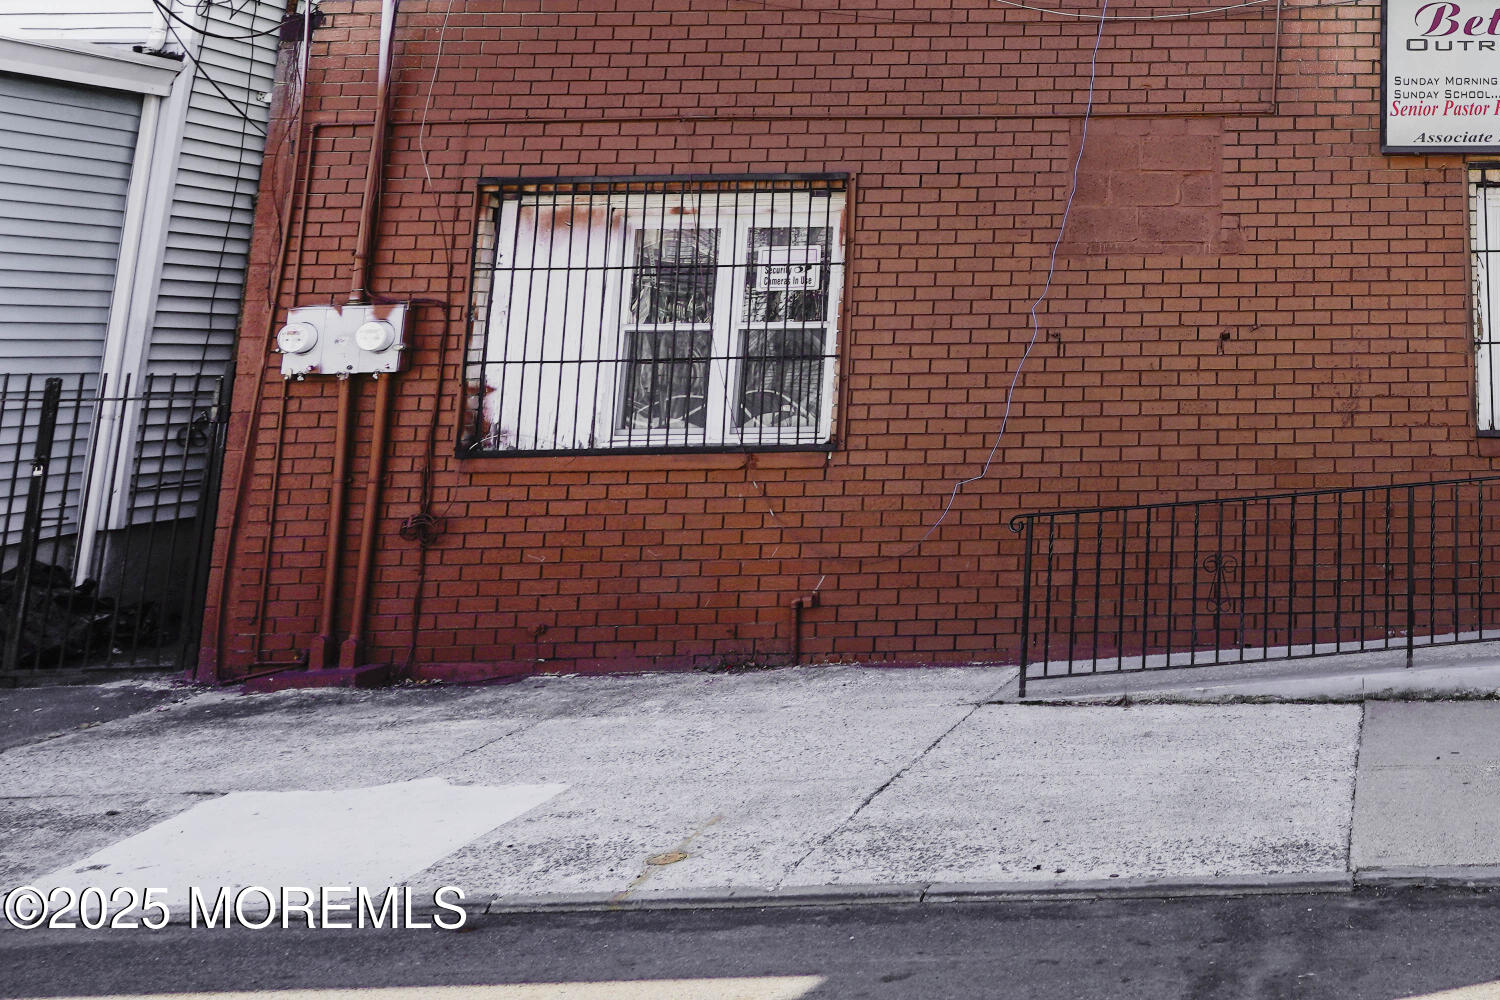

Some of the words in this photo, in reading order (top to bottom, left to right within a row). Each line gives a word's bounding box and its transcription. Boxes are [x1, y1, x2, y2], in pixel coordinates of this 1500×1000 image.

[1393, 76, 1440, 86] SUNDAY
[1445, 76, 1498, 86] MORNING
[1393, 89, 1440, 99] SUNDAY
[1389, 99, 1439, 117] Senior
[1443, 99, 1491, 117] Pastor
[1413, 131, 1493, 144] Associate
